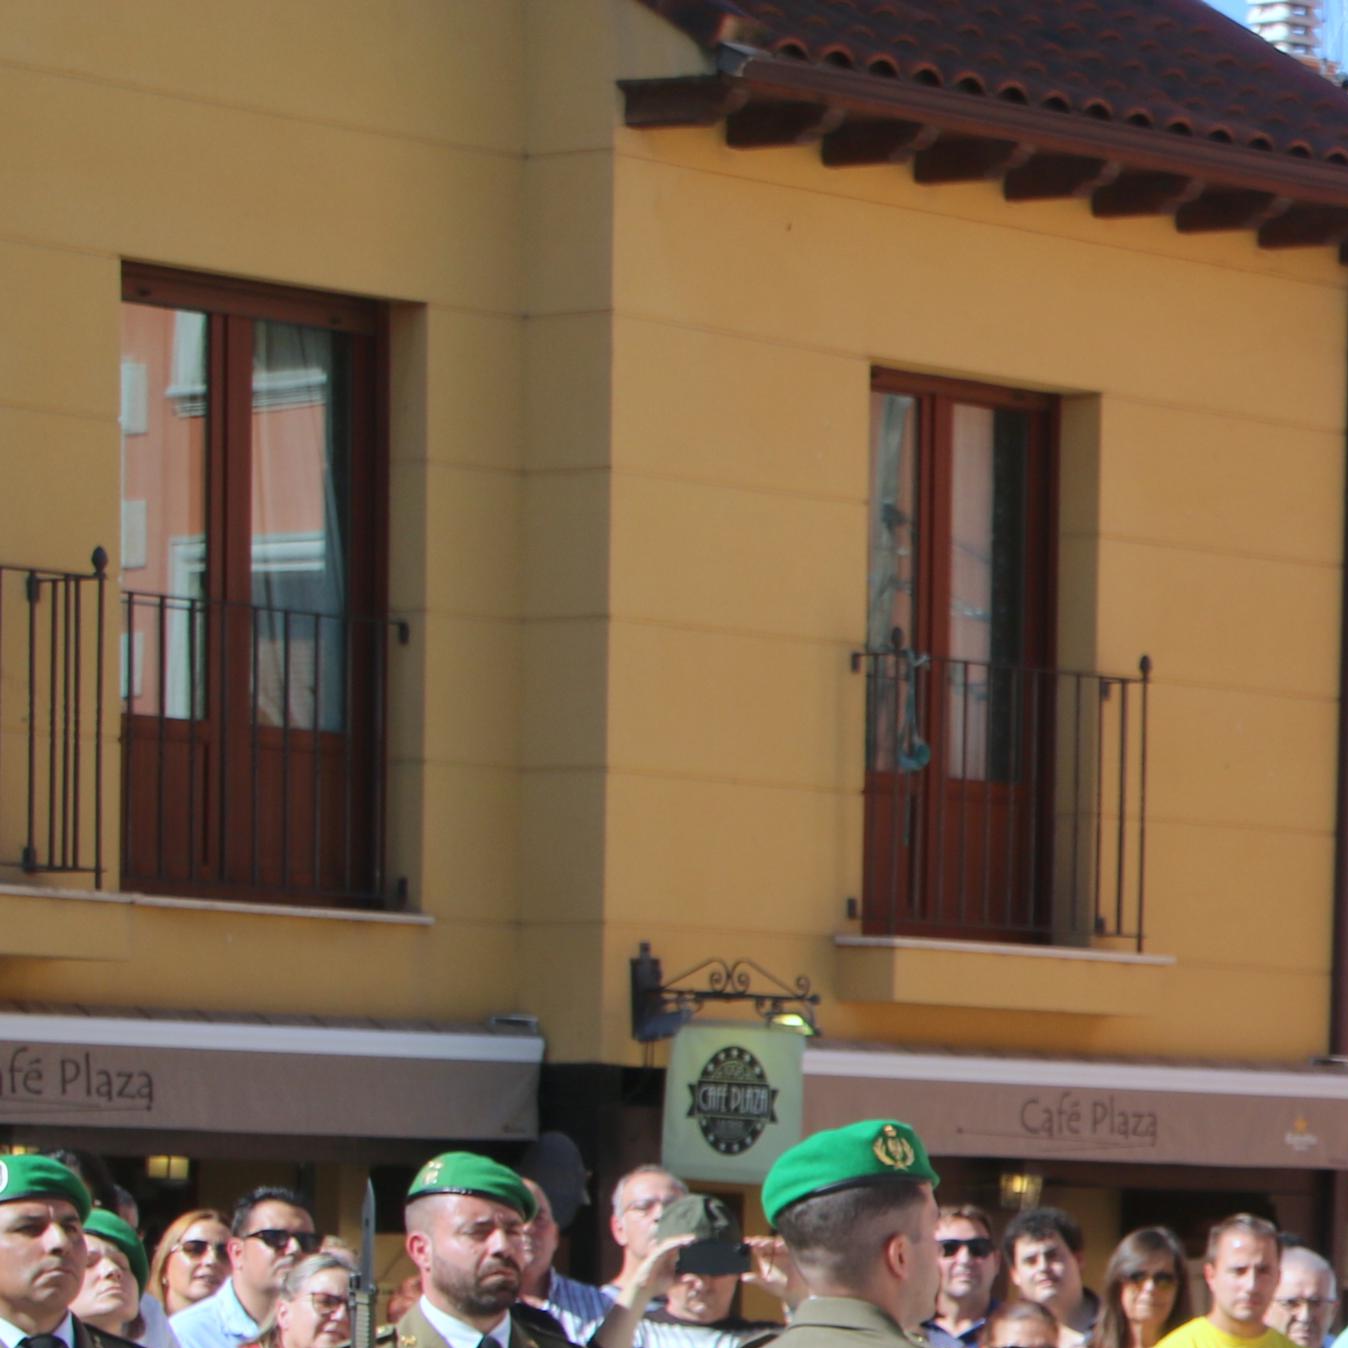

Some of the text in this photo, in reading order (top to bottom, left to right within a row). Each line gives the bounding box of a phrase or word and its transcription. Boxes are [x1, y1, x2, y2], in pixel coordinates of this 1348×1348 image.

[0, 1046, 154, 1110] fé Plaza
[730, 1085, 768, 1114] PLAZA
[1020, 1091, 1158, 1146] Café Plaza
